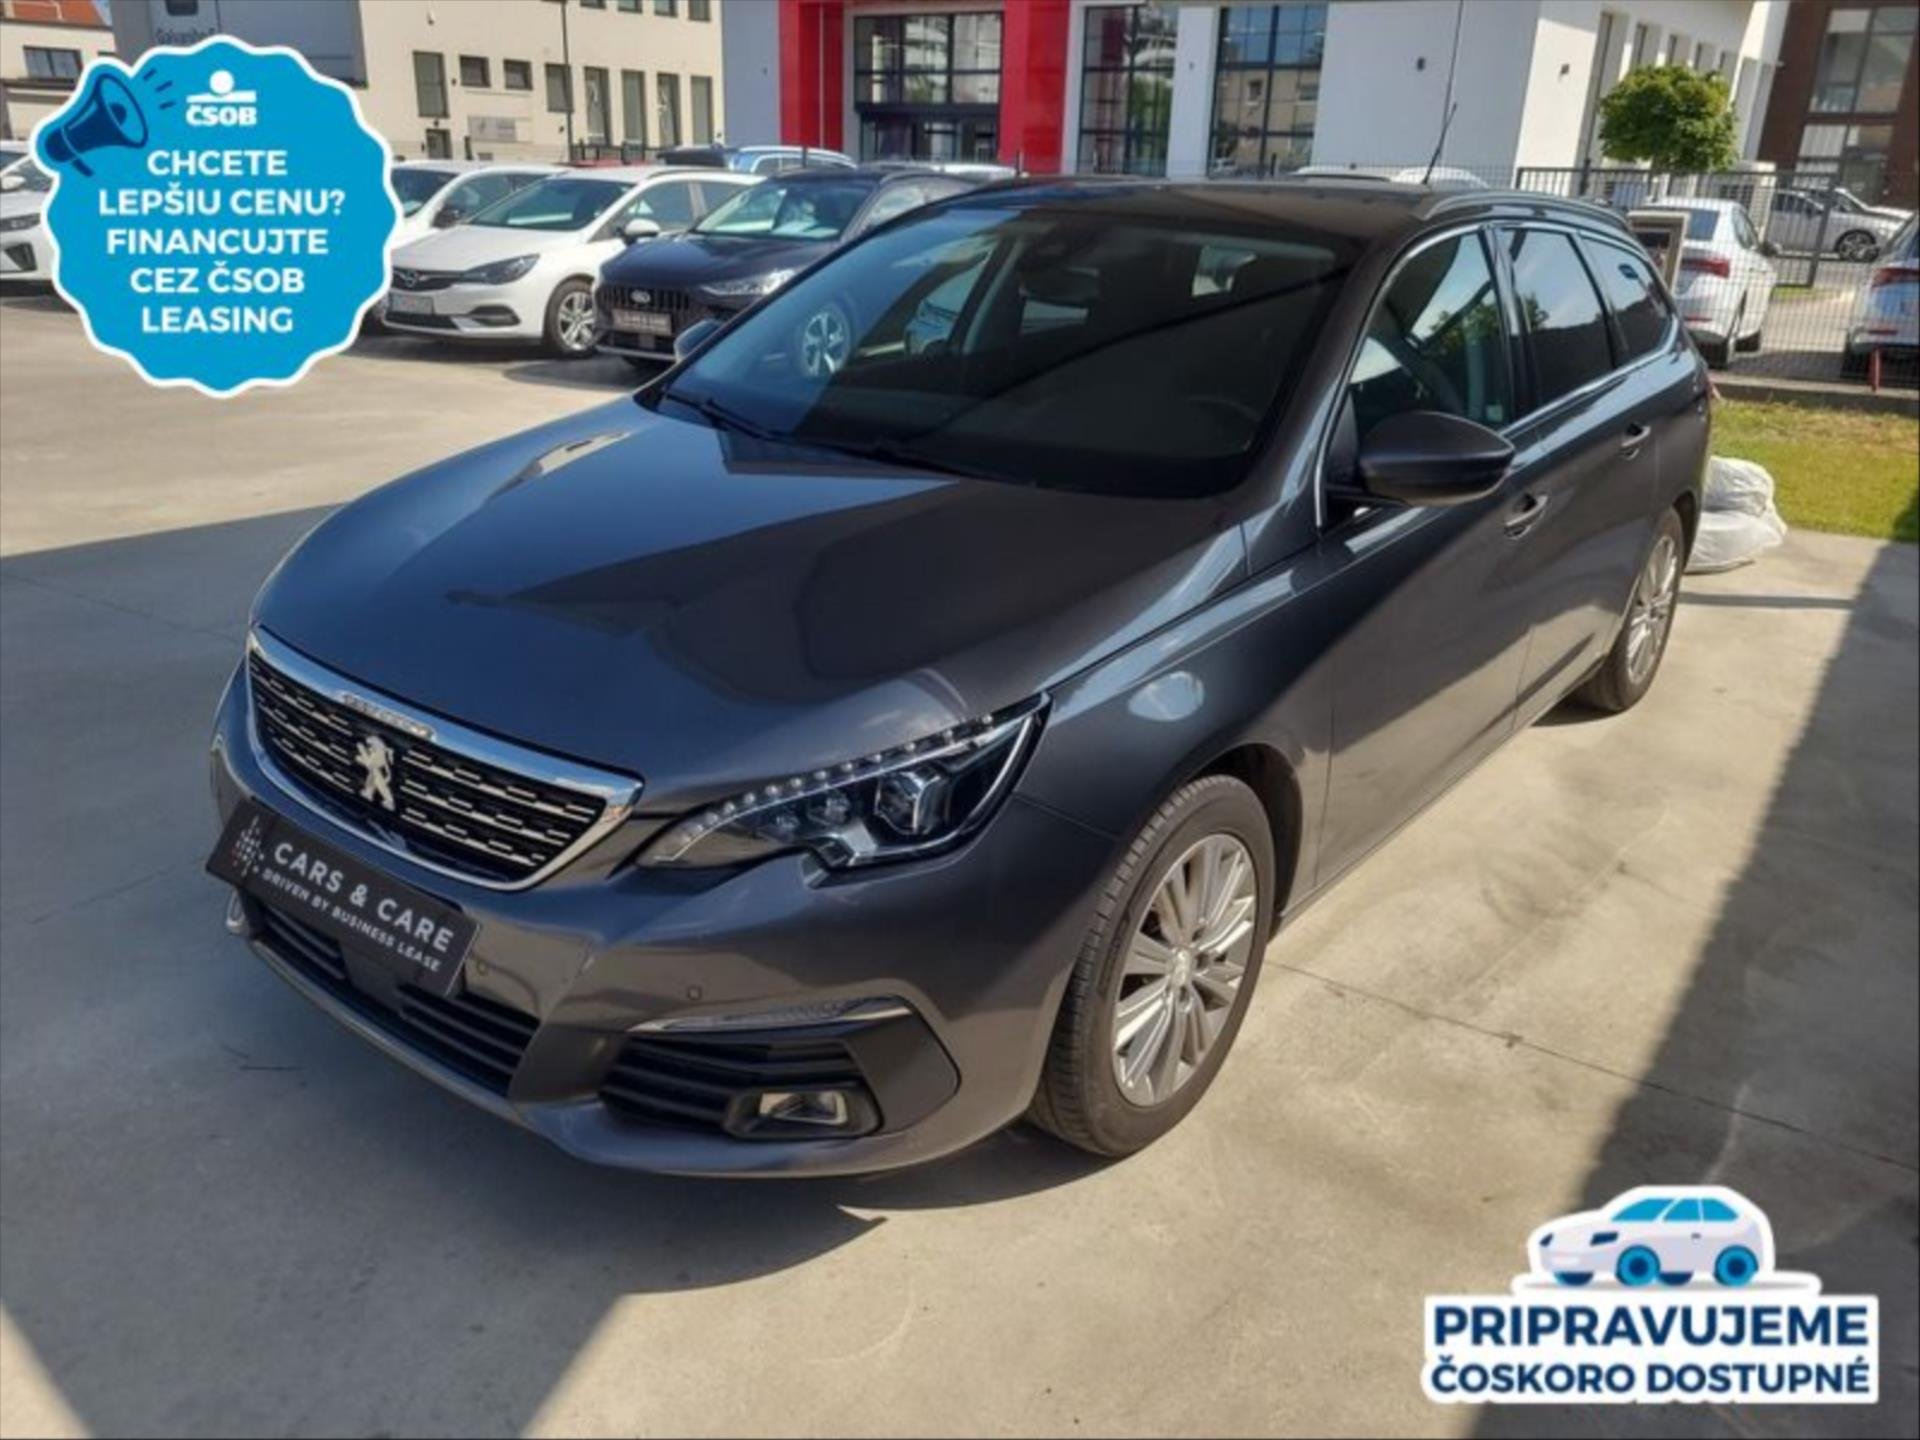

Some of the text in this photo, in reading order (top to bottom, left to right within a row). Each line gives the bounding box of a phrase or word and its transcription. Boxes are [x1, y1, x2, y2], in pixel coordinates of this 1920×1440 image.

[262, 868, 442, 973] DRIVEN BY BUSINESS LEASE
[274, 842, 455, 953] CARS & CARE
